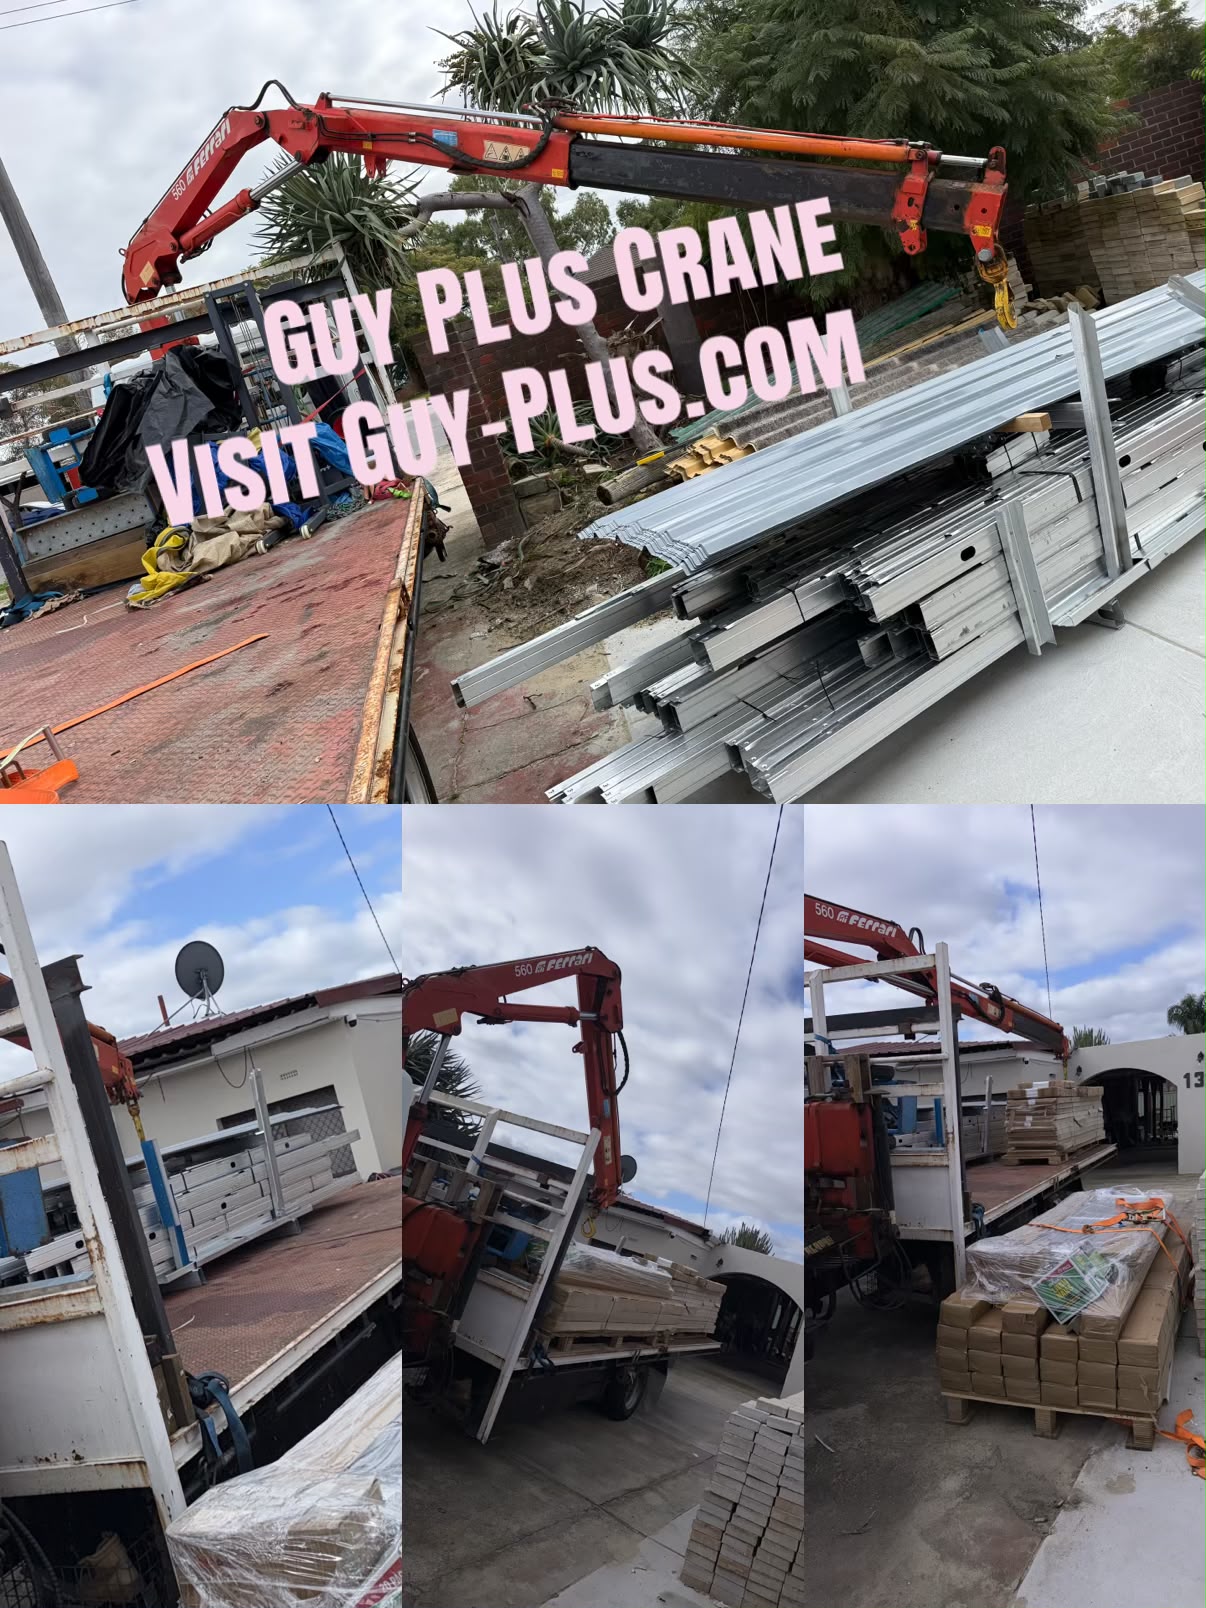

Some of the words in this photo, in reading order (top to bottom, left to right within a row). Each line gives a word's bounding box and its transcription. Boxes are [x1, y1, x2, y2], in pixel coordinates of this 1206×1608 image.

[172, 179, 187, 201] 560
[815, 902, 835, 920] 560
[514, 963, 533, 977] 560
[1183, 1071, 1204, 1089] 13
